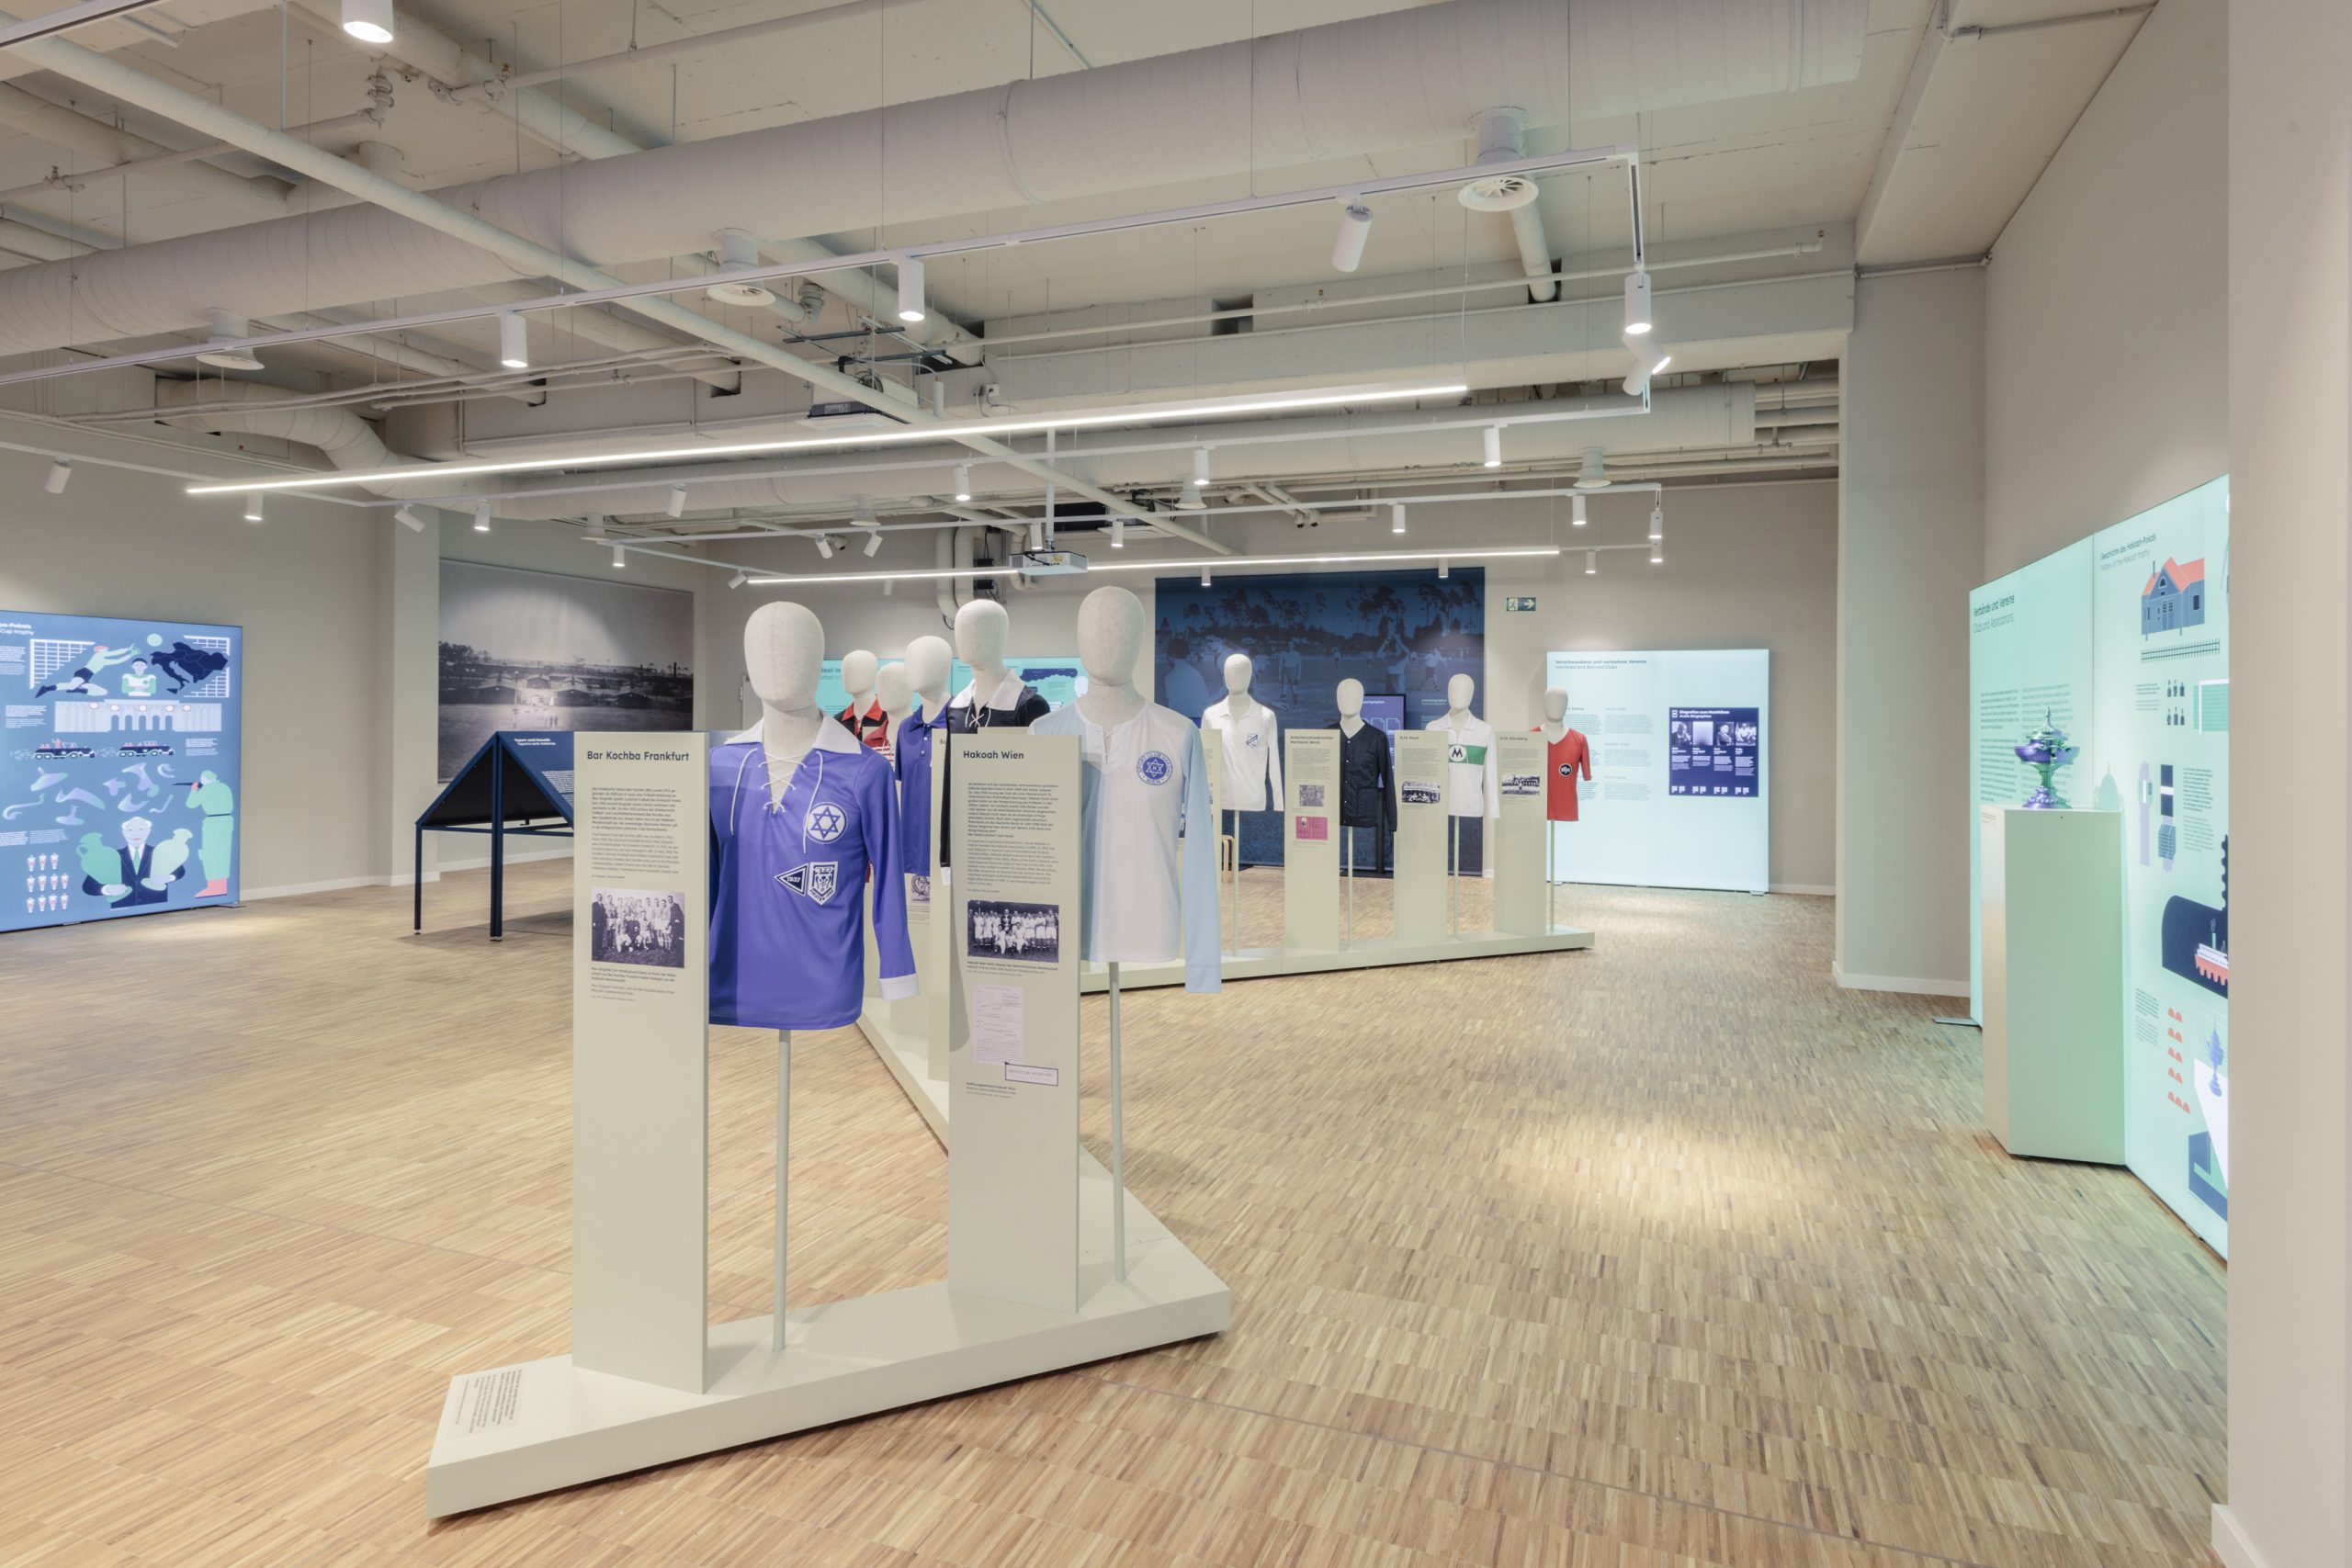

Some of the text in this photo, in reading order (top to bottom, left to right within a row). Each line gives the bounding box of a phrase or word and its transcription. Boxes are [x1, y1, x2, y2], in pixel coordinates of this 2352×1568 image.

[587, 750, 690, 761] Bar Kochba Frankfurt
[963, 750, 1024, 760] Hakoah Wien
